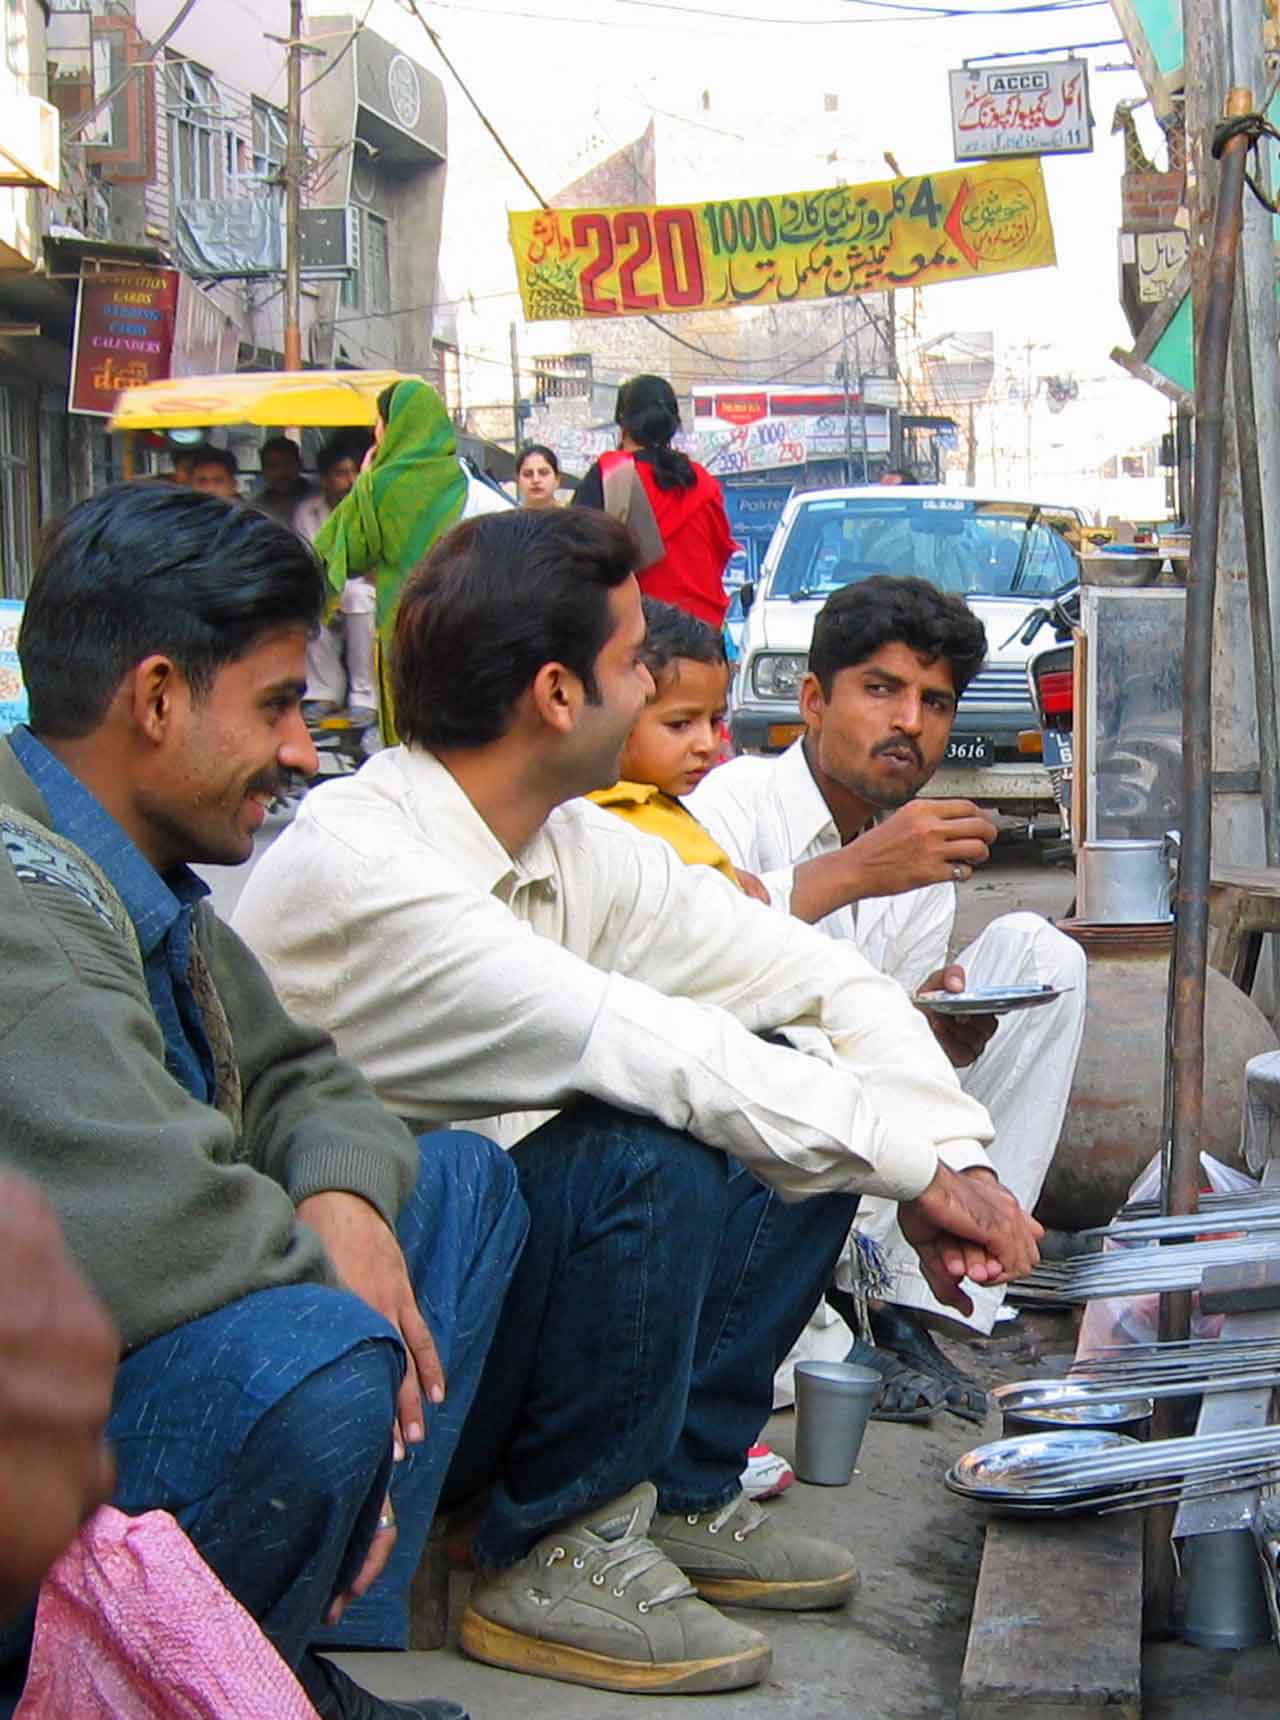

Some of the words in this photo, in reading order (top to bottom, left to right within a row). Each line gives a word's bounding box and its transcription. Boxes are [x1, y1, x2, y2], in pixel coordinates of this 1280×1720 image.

[993, 75, 1044, 91] ACCC
[703, 197, 777, 256] 1000
[910, 176, 943, 229] 4
[571, 209, 704, 314] 220
[947, 743, 985, 758] 3616
